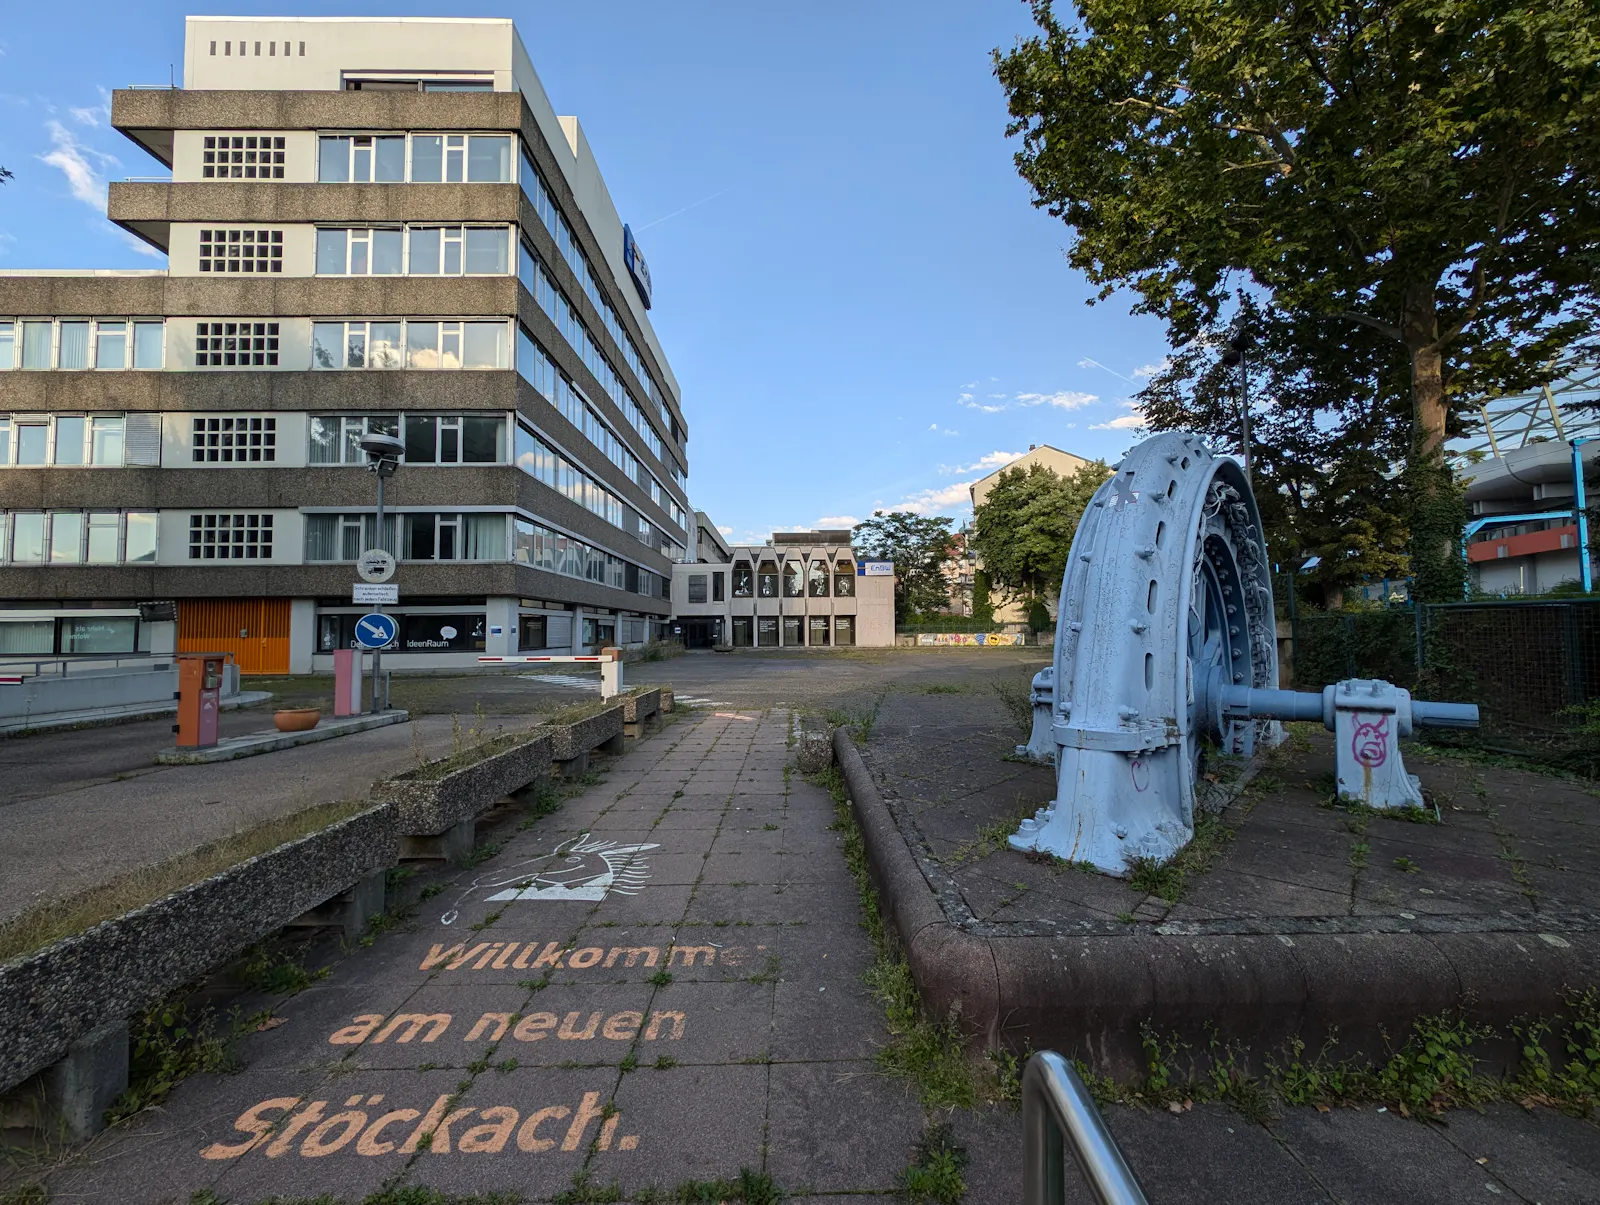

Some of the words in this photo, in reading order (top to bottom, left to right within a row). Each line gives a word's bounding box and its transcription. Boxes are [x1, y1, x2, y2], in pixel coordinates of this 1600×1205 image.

[406, 640, 449, 648] IdeenRaum
[418, 941, 767, 971] Willkomme
[328, 1012, 453, 1046] am
[462, 1010, 687, 1043] neuen
[199, 1091, 640, 1160] Stöckach.
